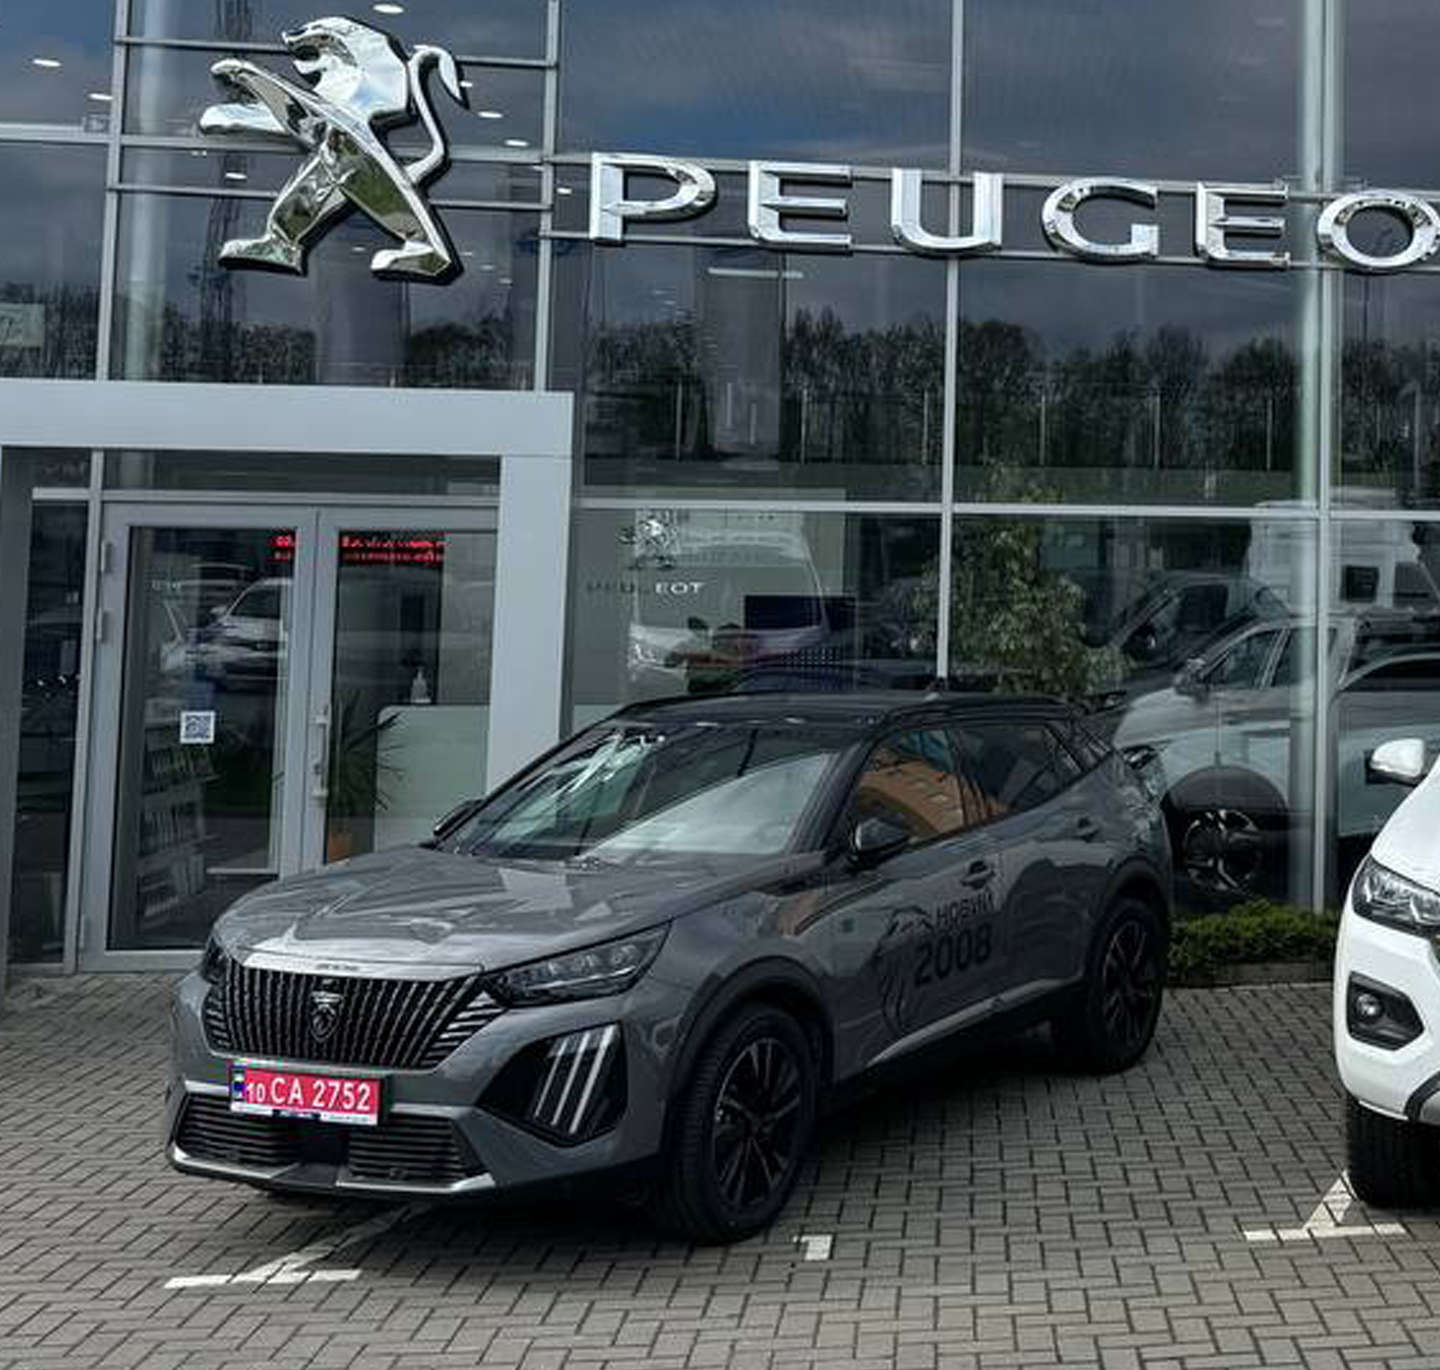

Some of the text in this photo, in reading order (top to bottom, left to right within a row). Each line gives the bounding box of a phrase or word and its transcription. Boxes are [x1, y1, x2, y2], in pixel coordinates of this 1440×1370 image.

[914, 921, 993, 988] 2008
[247, 1077, 371, 1111] 10 CA 2752
